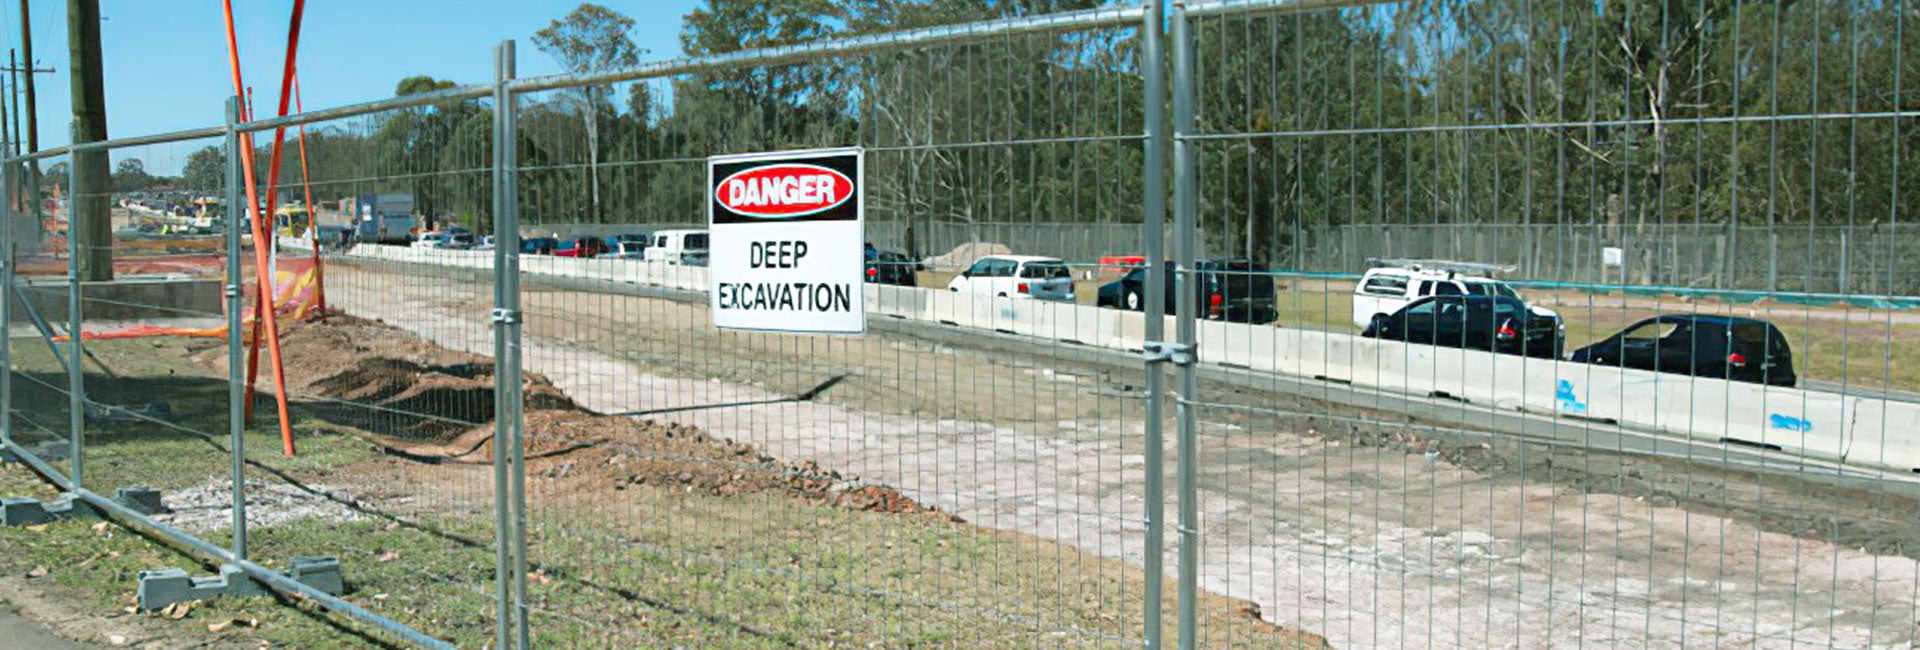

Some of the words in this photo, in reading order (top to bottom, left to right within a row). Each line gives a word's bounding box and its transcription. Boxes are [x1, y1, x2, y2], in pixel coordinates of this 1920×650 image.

[728, 174, 836, 207] DANGER
[750, 240, 808, 269] DEEP
[718, 282, 851, 312] EXCAVATION
